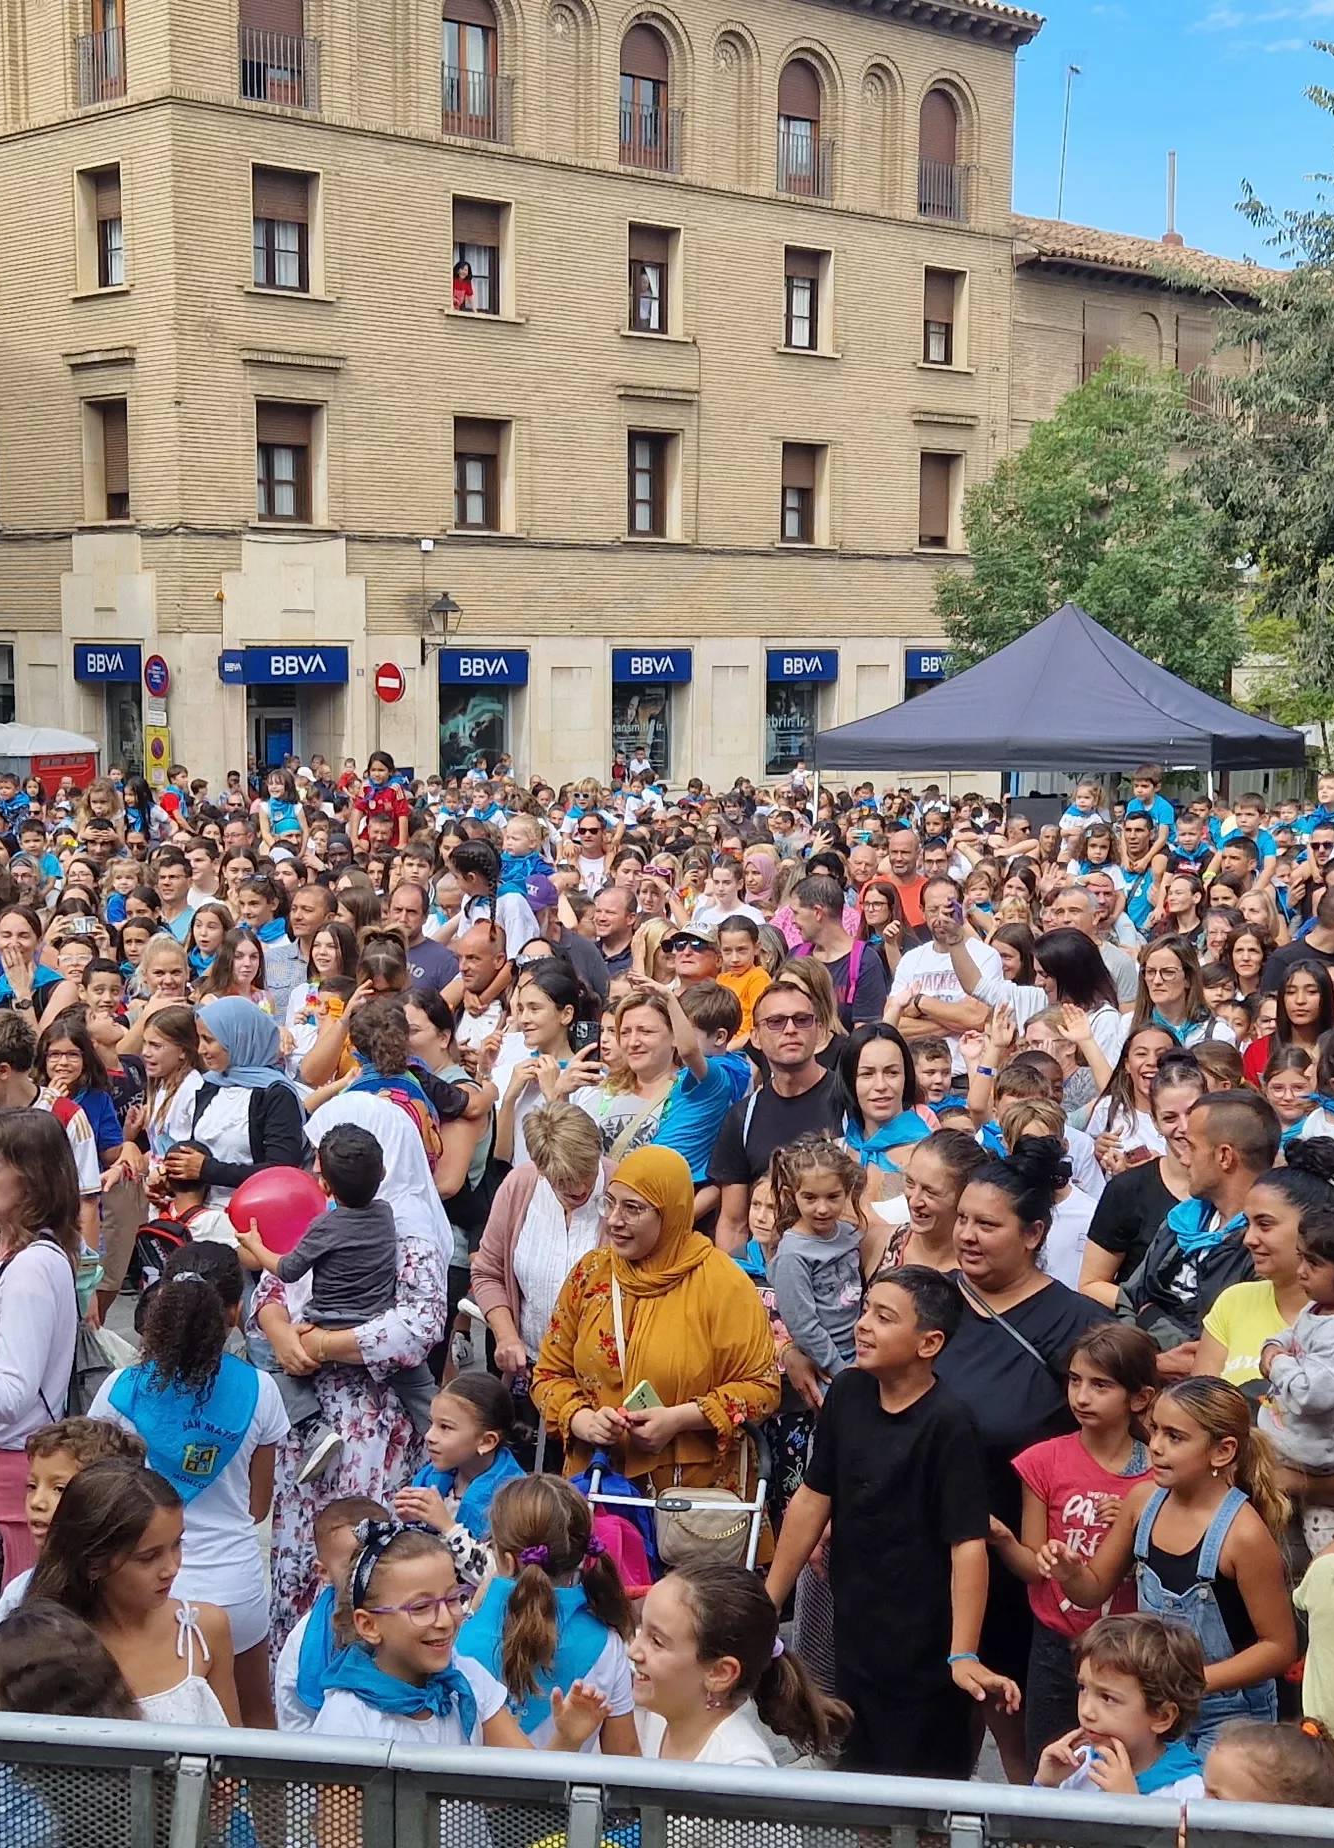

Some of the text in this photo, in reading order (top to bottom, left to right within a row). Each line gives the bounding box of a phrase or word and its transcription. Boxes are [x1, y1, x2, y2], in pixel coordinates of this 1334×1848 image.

[87, 652, 124, 673] BBVA
[271, 653, 327, 676] BBVA
[460, 656, 509, 676] BBVA
[631, 655, 675, 675] BBVA
[783, 656, 823, 675] BBVA
[182, 1418, 201, 1432] SAN
